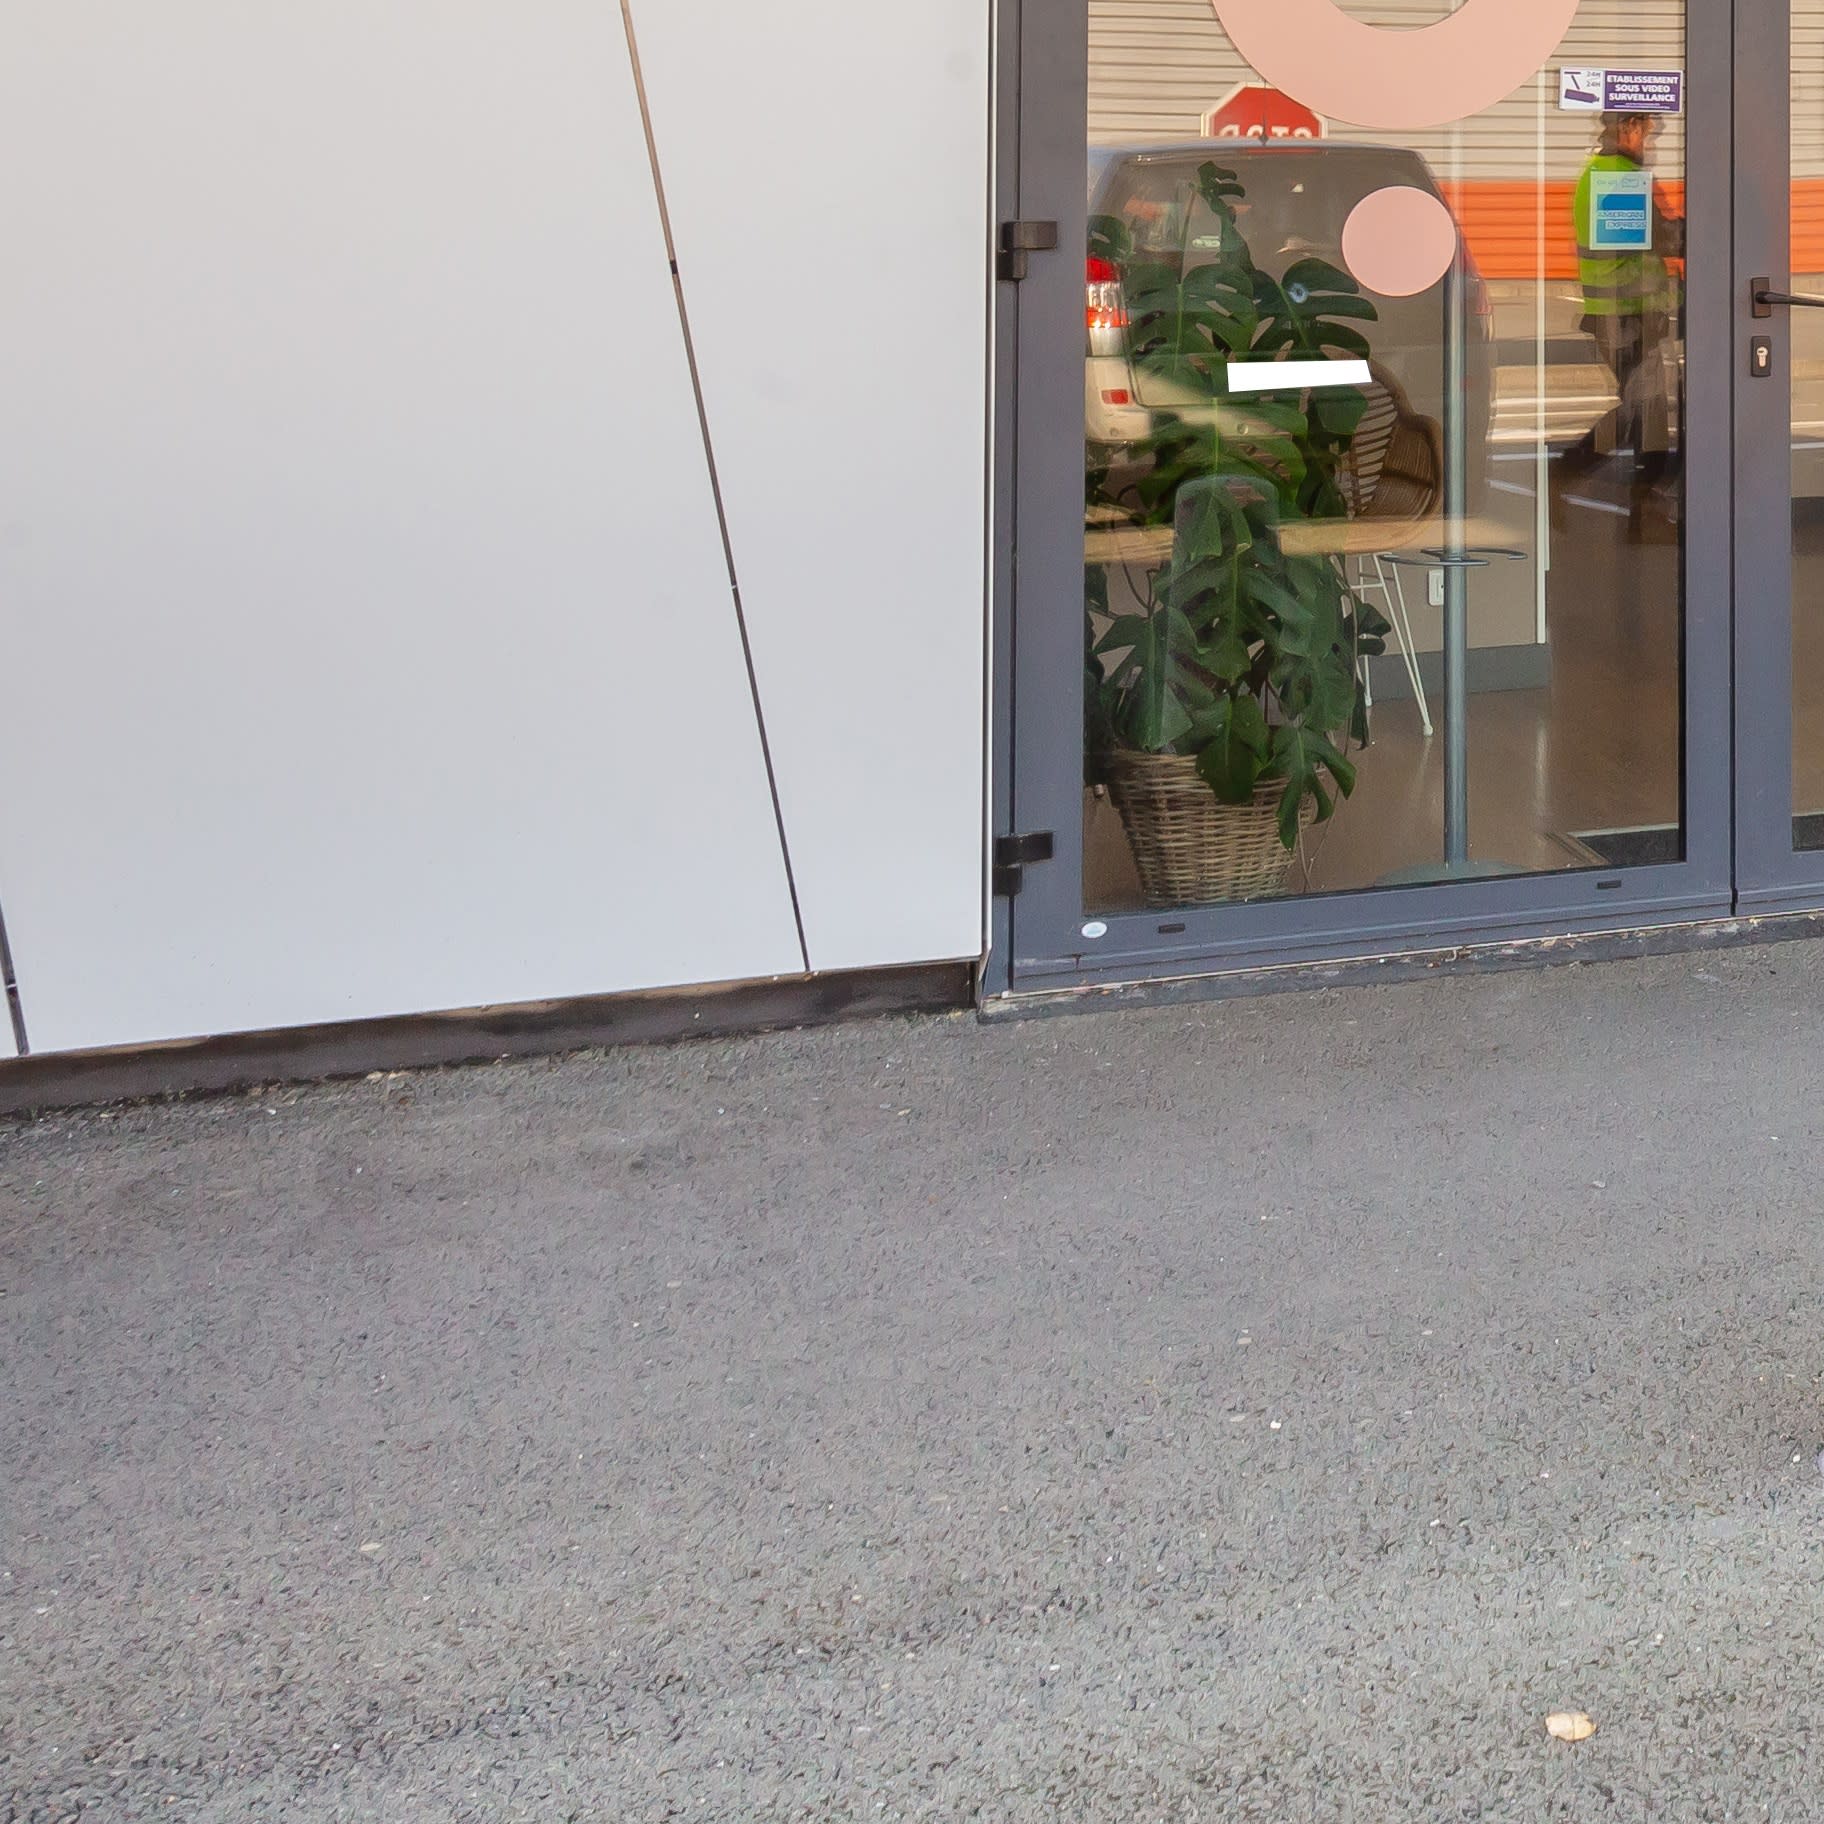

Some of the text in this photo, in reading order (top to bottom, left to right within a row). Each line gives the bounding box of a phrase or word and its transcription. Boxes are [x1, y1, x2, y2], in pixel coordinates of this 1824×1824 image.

[1607, 74, 1679, 85] ETABLISSEMENT
[1614, 84, 1671, 93] SOUS VIDEO
[1609, 92, 1676, 103] SURVEILLANCE
